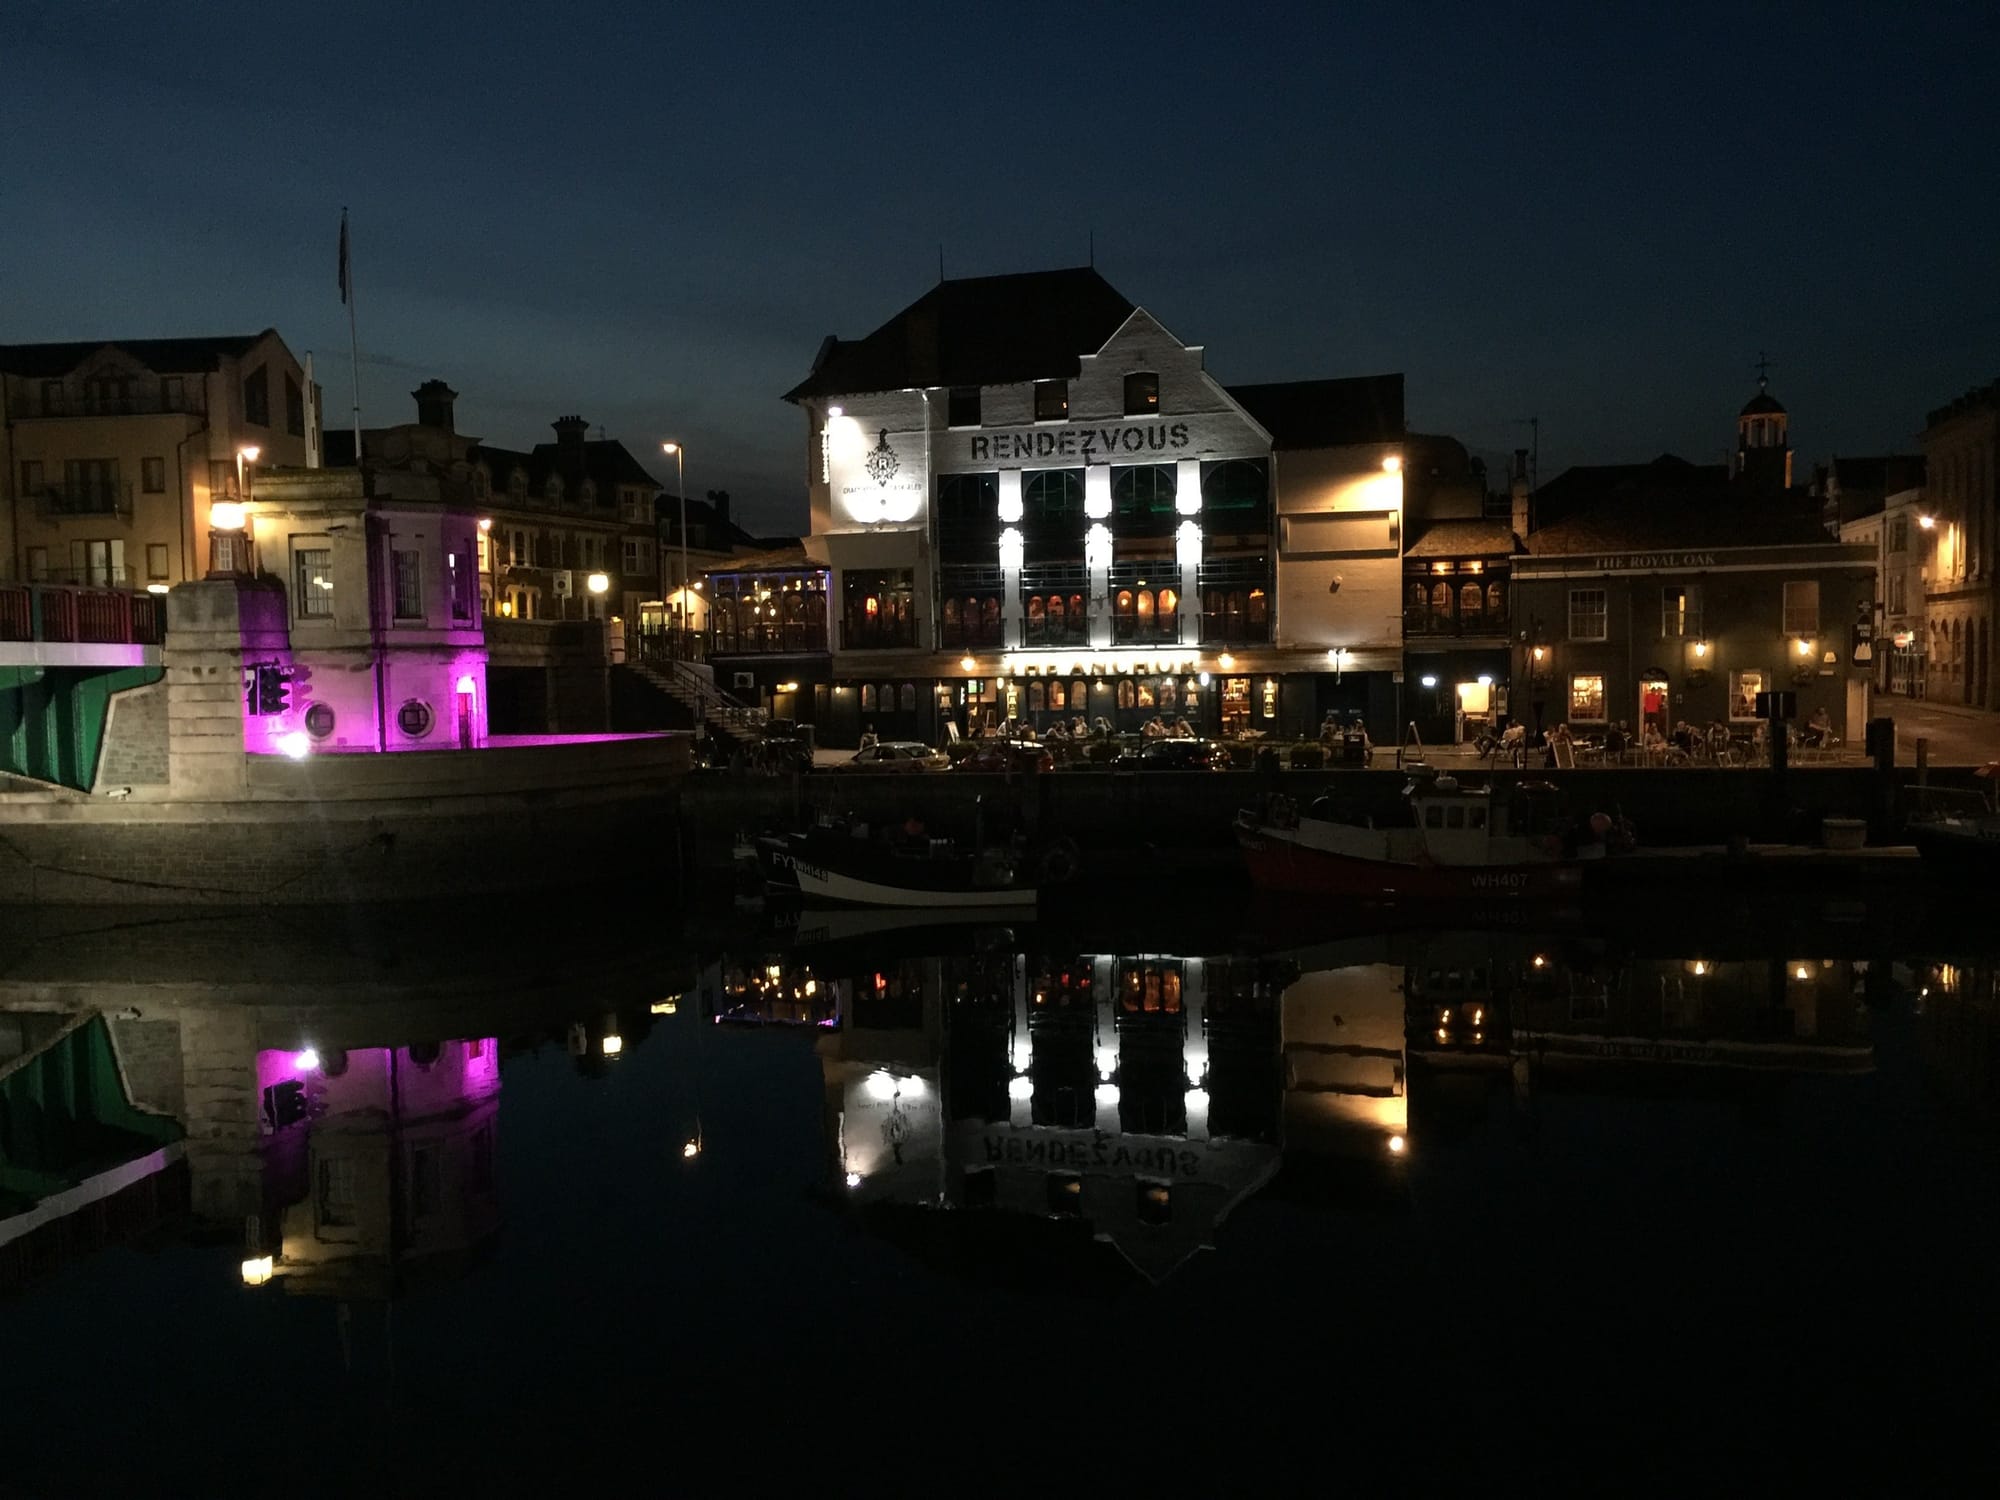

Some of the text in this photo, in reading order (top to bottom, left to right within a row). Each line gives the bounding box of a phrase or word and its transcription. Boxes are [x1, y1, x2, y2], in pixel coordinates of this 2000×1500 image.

[971, 422, 1189, 460] RENDEZVOUS
[1595, 552, 1715, 569] THE ROYAL OAK
[1471, 871, 1528, 889] WH407
